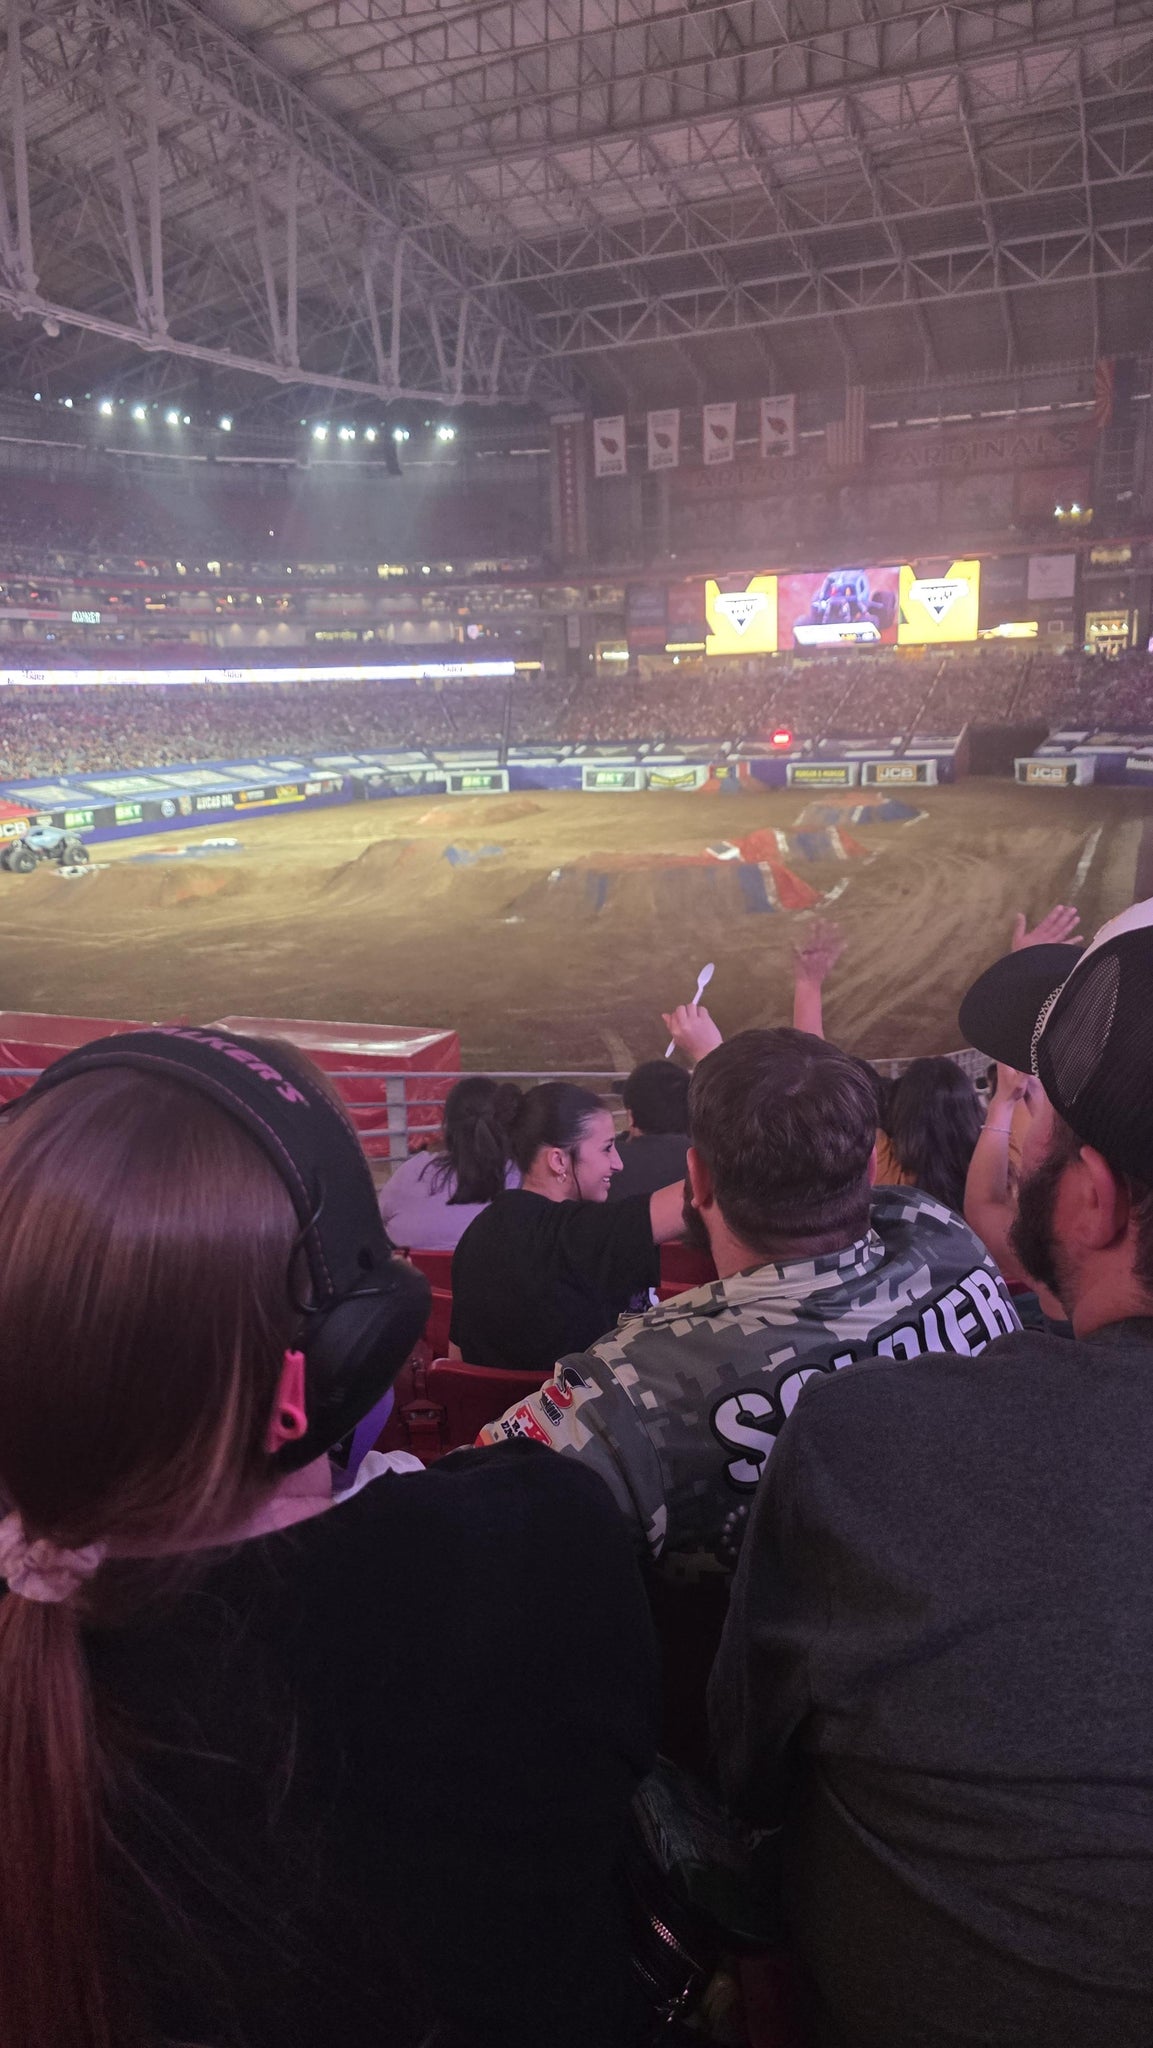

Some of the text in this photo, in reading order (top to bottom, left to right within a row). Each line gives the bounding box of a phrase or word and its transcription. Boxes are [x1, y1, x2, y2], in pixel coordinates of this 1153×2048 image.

[874, 429, 1080, 469] CARDINALS
[879, 767, 914, 778] JCB
[1030, 767, 1062, 778] JCB
[197, 793, 234, 809] LUCAS OIL
[65, 811, 94, 827] BKT
[0, 821, 27, 838] CB
